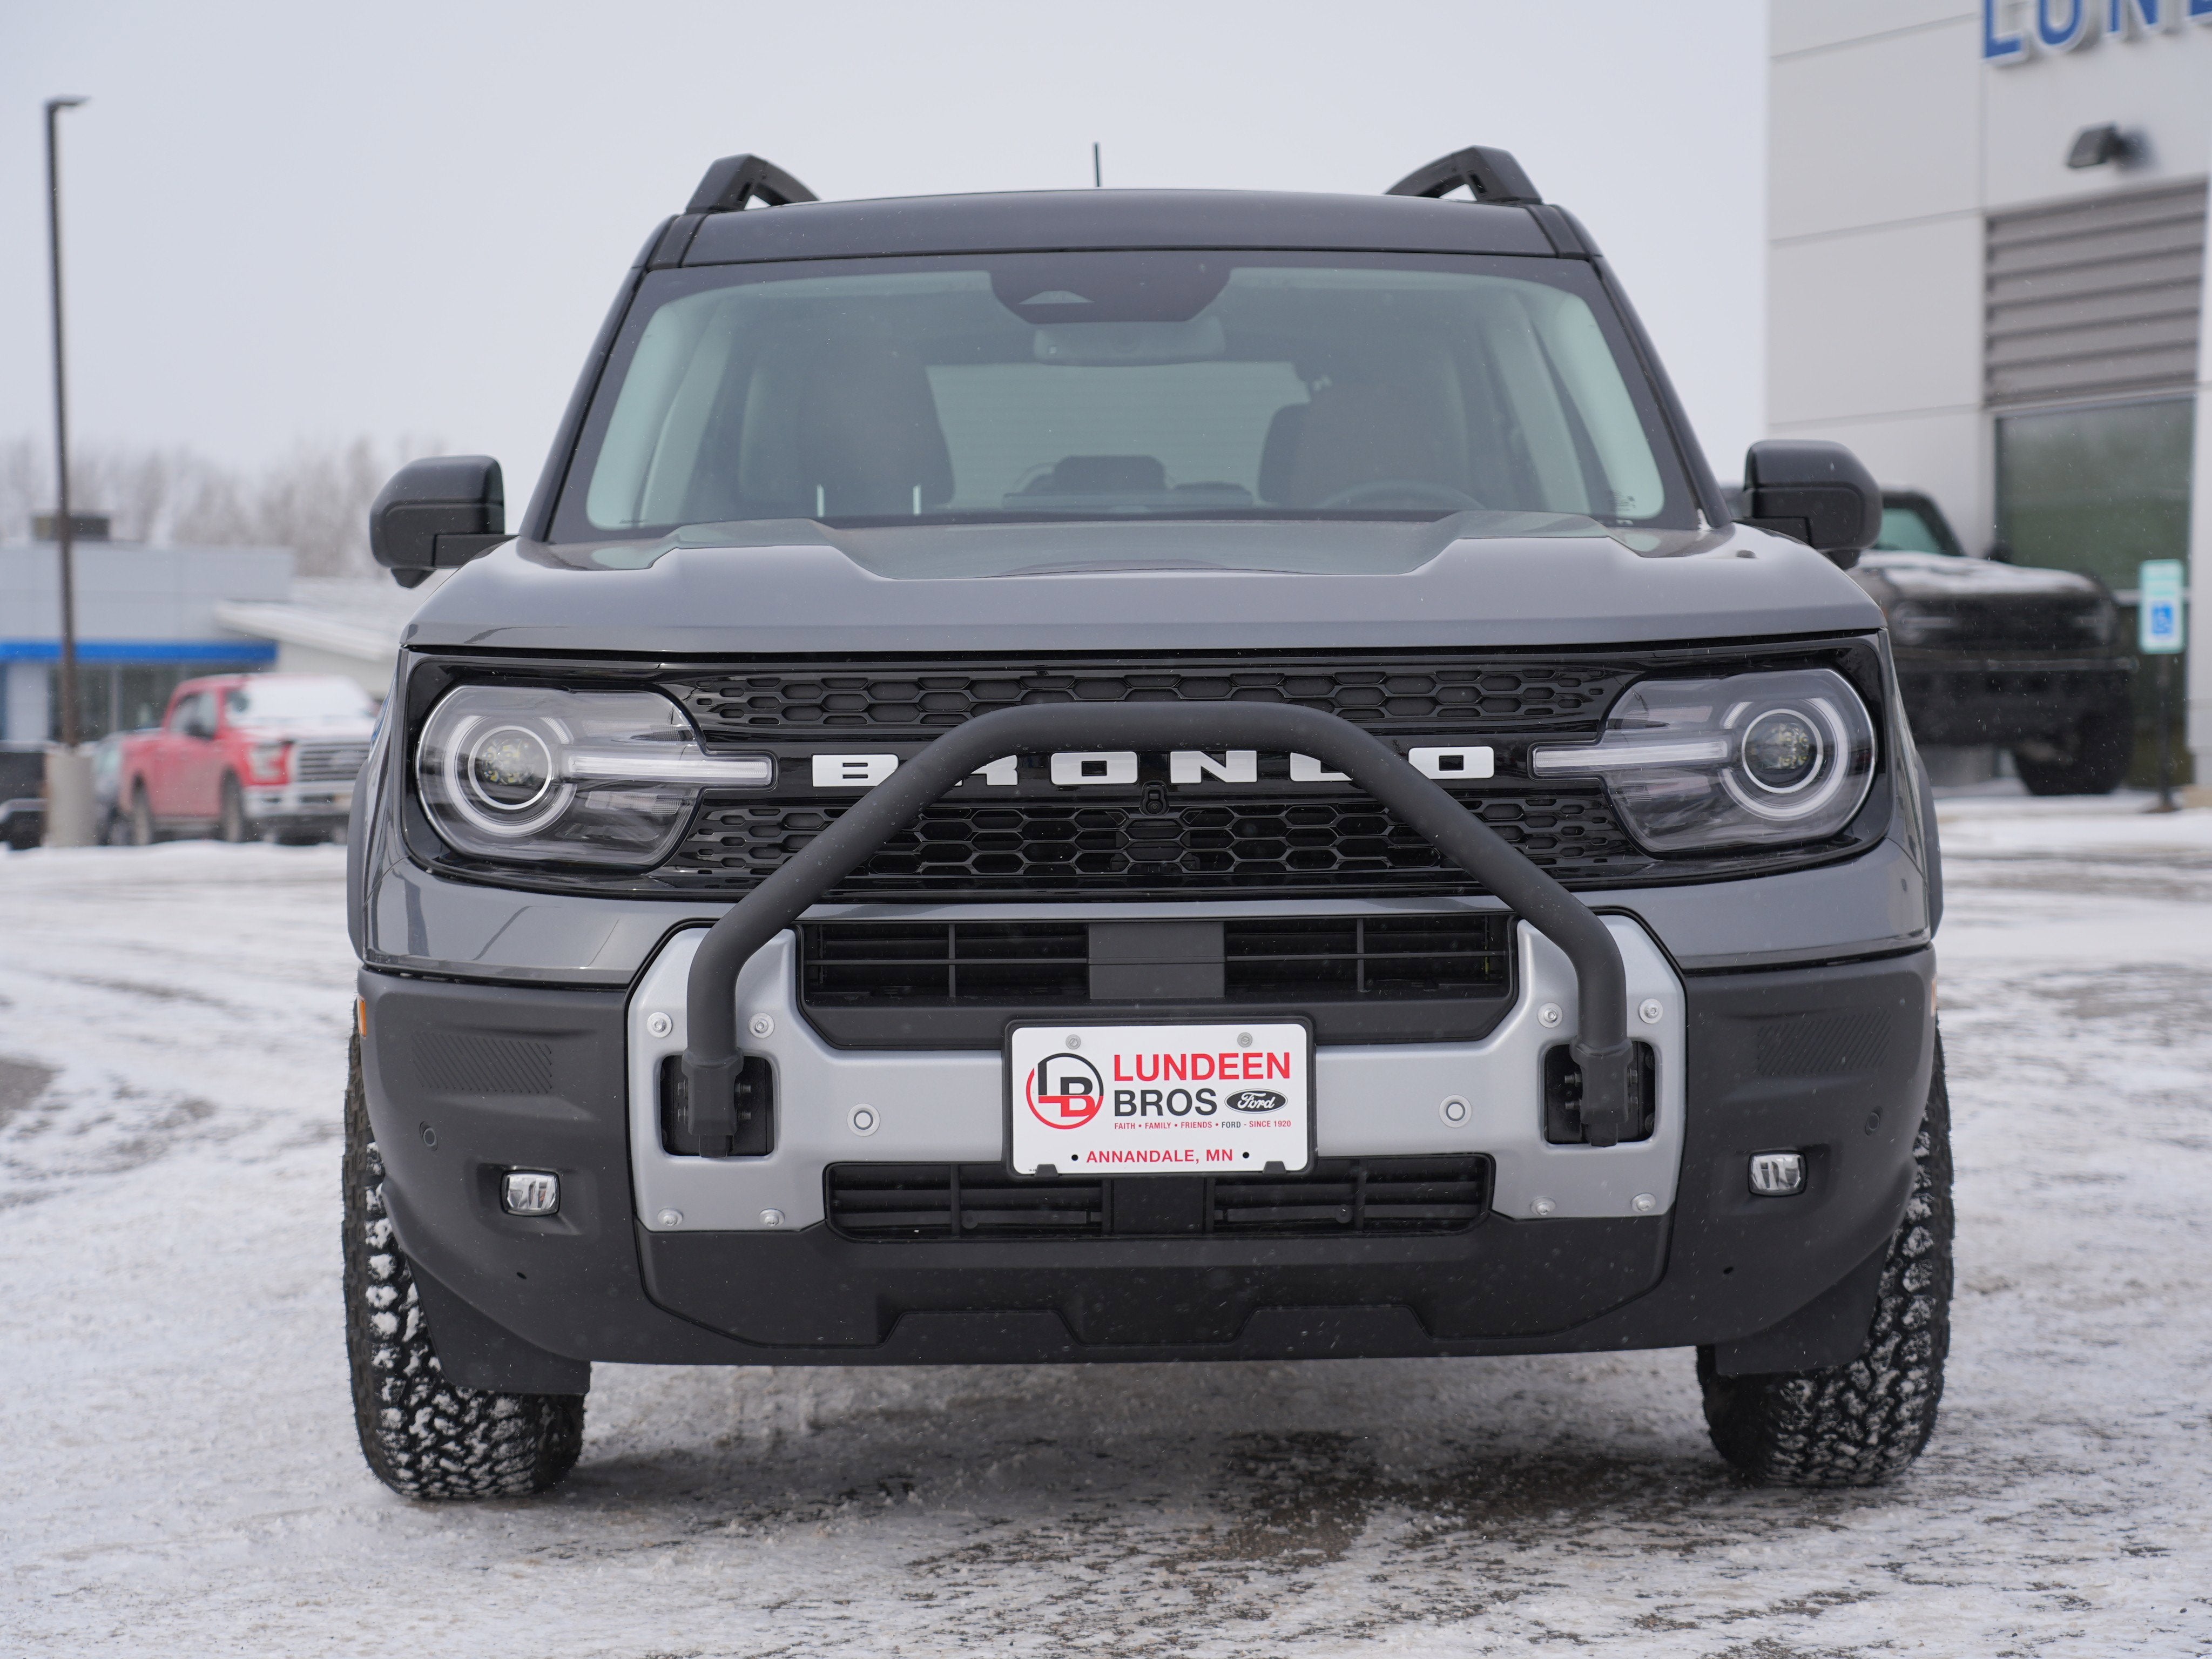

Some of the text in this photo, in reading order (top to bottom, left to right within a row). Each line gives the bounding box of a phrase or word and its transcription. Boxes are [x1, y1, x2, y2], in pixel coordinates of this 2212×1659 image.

[1984, 0, 2212, 58] LU
[1114, 1052, 1290, 1082] LUNDEEN
[1114, 1088, 1217, 1117] BROS
[1237, 1092, 1276, 1109] Ford
[1086, 1149, 1232, 1164] ANNANDALE, MN
